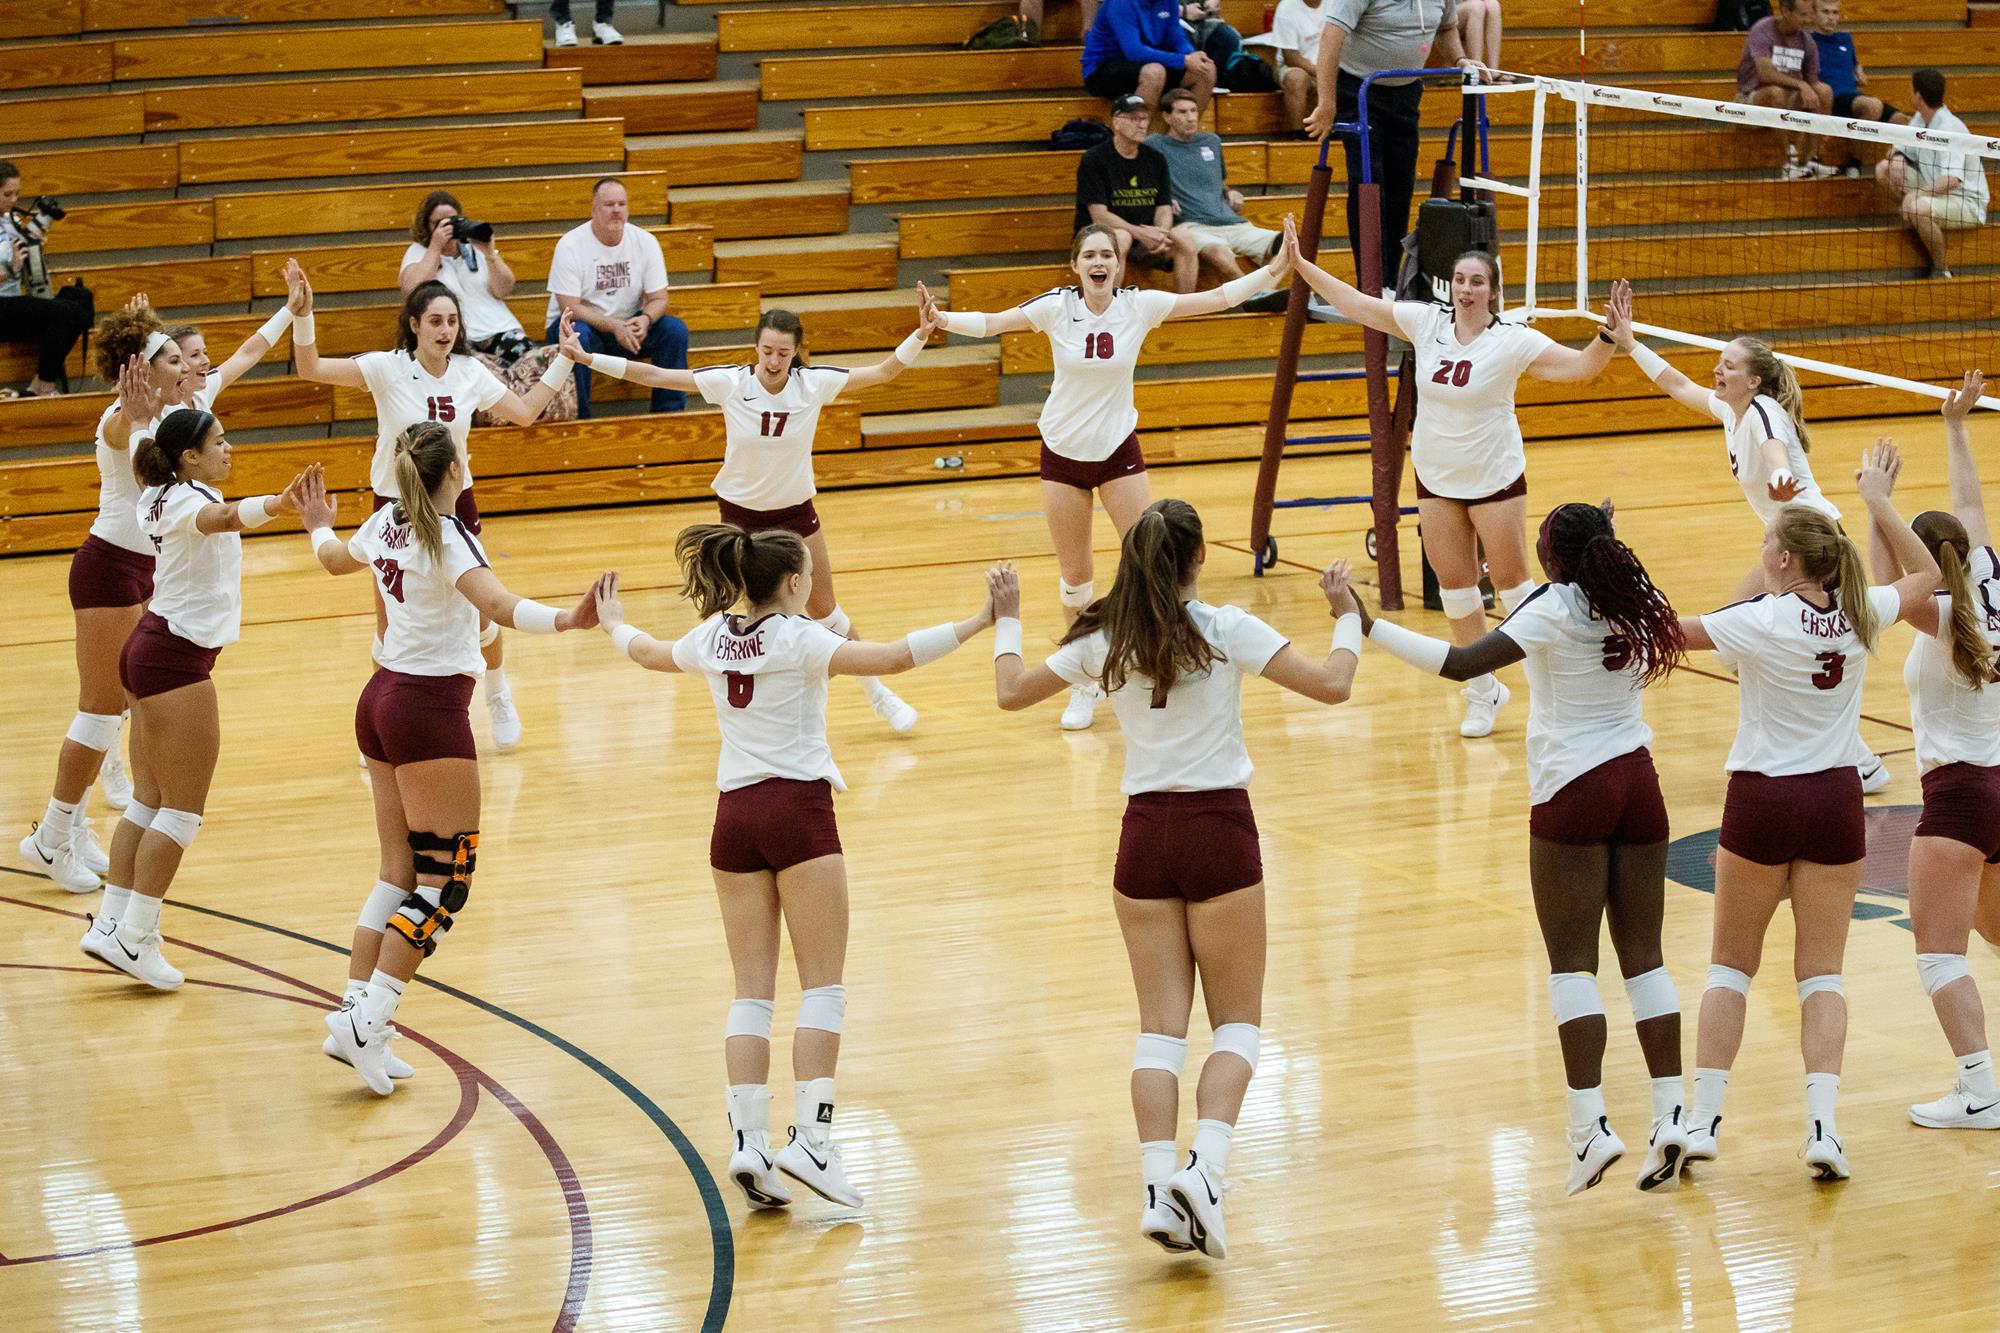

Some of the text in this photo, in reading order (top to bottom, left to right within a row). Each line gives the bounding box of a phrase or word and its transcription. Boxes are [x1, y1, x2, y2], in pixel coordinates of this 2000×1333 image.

[596, 261, 631, 280] ERSKINE
[1085, 332, 1114, 359] 18
[1432, 360, 1473, 387] 20
[427, 395, 456, 422] 15
[760, 411, 790, 437] 17
[1811, 652, 1847, 690] 3
